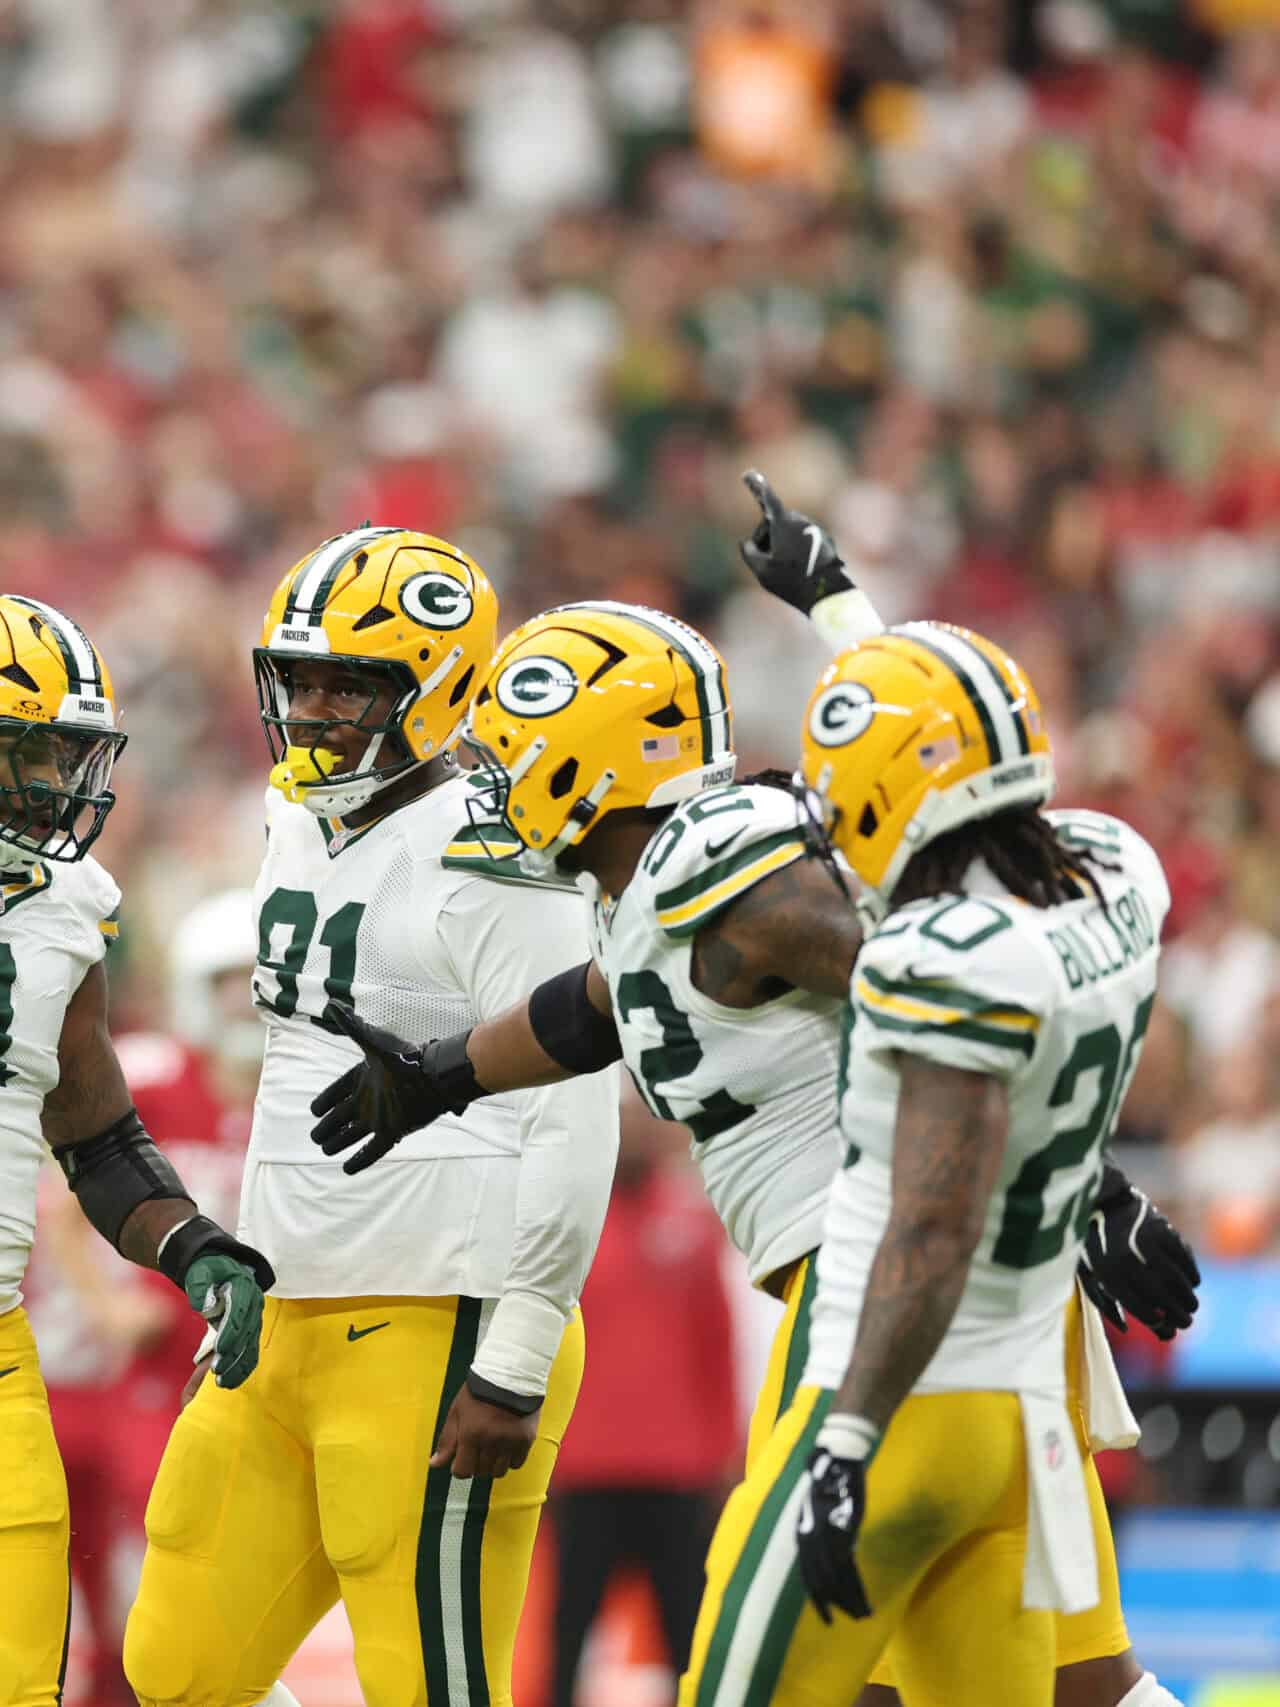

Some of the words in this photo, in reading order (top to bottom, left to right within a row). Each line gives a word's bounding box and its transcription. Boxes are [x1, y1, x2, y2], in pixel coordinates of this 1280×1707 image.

[400, 572, 473, 630] G
[281, 629, 310, 642] PACKERS
[78, 699, 105, 714] PACKERS
[496, 656, 578, 718] G
[252, 886, 367, 1035] 91
